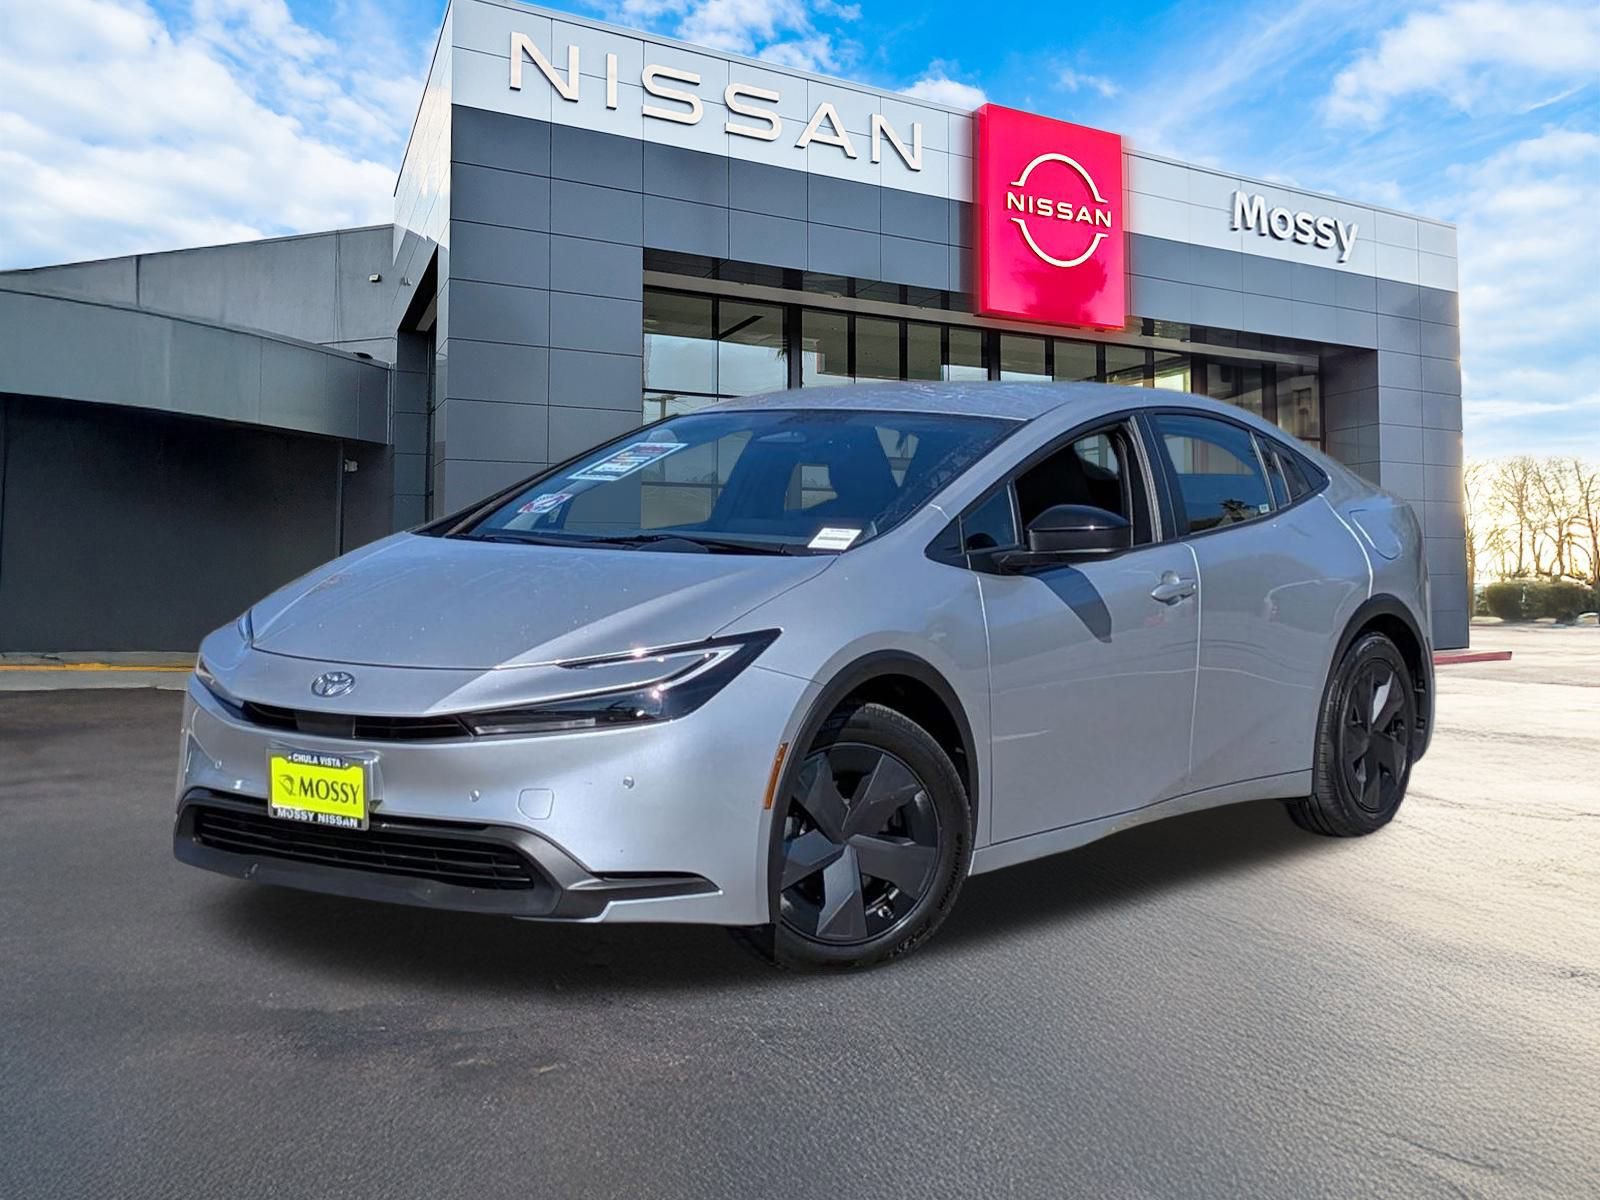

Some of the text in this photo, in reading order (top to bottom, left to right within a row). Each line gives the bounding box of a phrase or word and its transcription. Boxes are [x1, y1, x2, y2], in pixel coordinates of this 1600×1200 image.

[509, 31, 922, 172] NISSAN
[1006, 191, 1112, 228] NISSAN
[1230, 190, 1359, 264] Mossy
[292, 753, 341, 768] CHULA VISTA
[299, 776, 360, 805] MOSSY
[277, 808, 358, 828] MOSSY NISSAN
